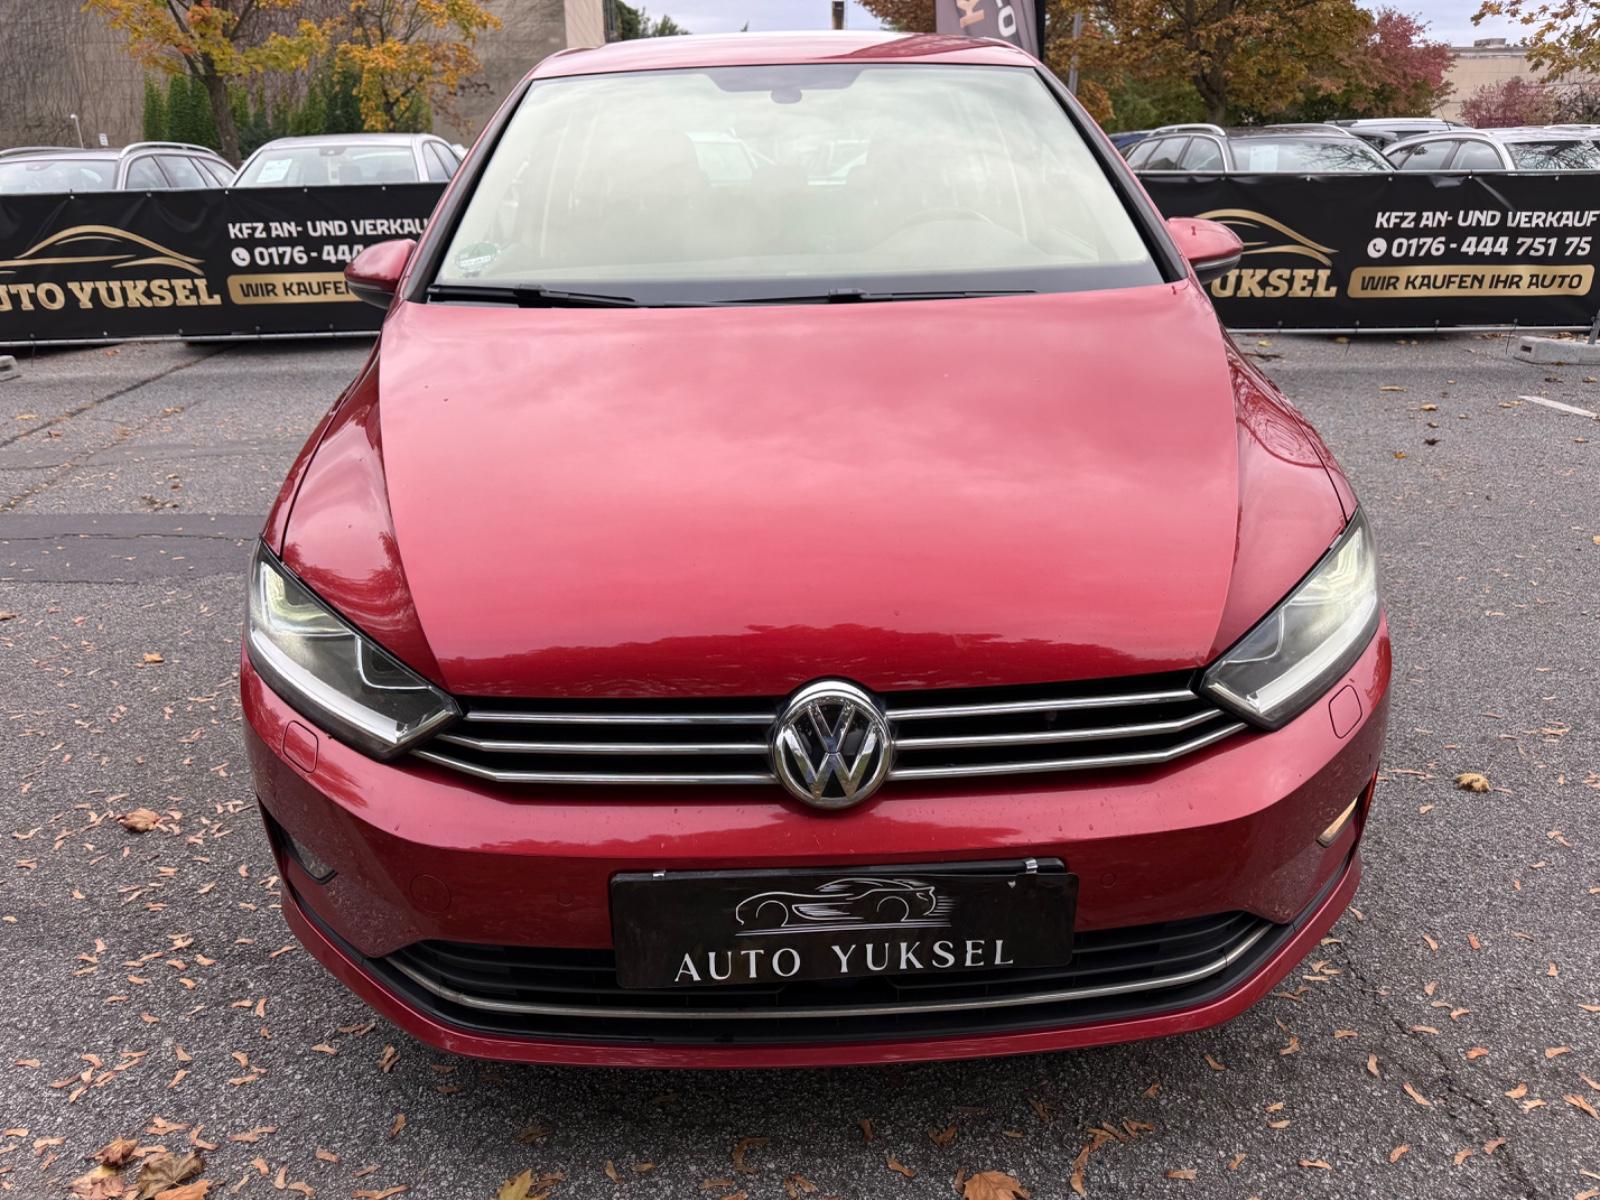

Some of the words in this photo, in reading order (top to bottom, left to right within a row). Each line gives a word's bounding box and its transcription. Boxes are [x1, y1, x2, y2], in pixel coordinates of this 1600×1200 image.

[227, 222, 267, 239] KFZ
[269, 221, 303, 238] AN-
[306, 220, 348, 237] UND
[1375, 211, 1416, 228] KFZ
[1419, 210, 1453, 228] AN-
[1457, 210, 1501, 227] UND
[1507, 210, 1600, 228] VERKAUF
[253, 245, 308, 266] 0176
[1391, 236, 1446, 258] 0176
[1460, 236, 1509, 256] 444
[1516, 237, 1558, 257] 751
[1564, 236, 1592, 257] 75
[239, 282, 278, 298] WIR
[1360, 276, 1399, 291] WIR
[1404, 274, 1485, 290] KAUFEN
[1488, 274, 1523, 289] IHR
[1527, 274, 1583, 289] AUTO
[66, 278, 222, 309] YUKSEL
[780, 698, 882, 801] VW
[674, 948, 801, 982] AUTO
[831, 939, 1014, 974] YUKSEL
